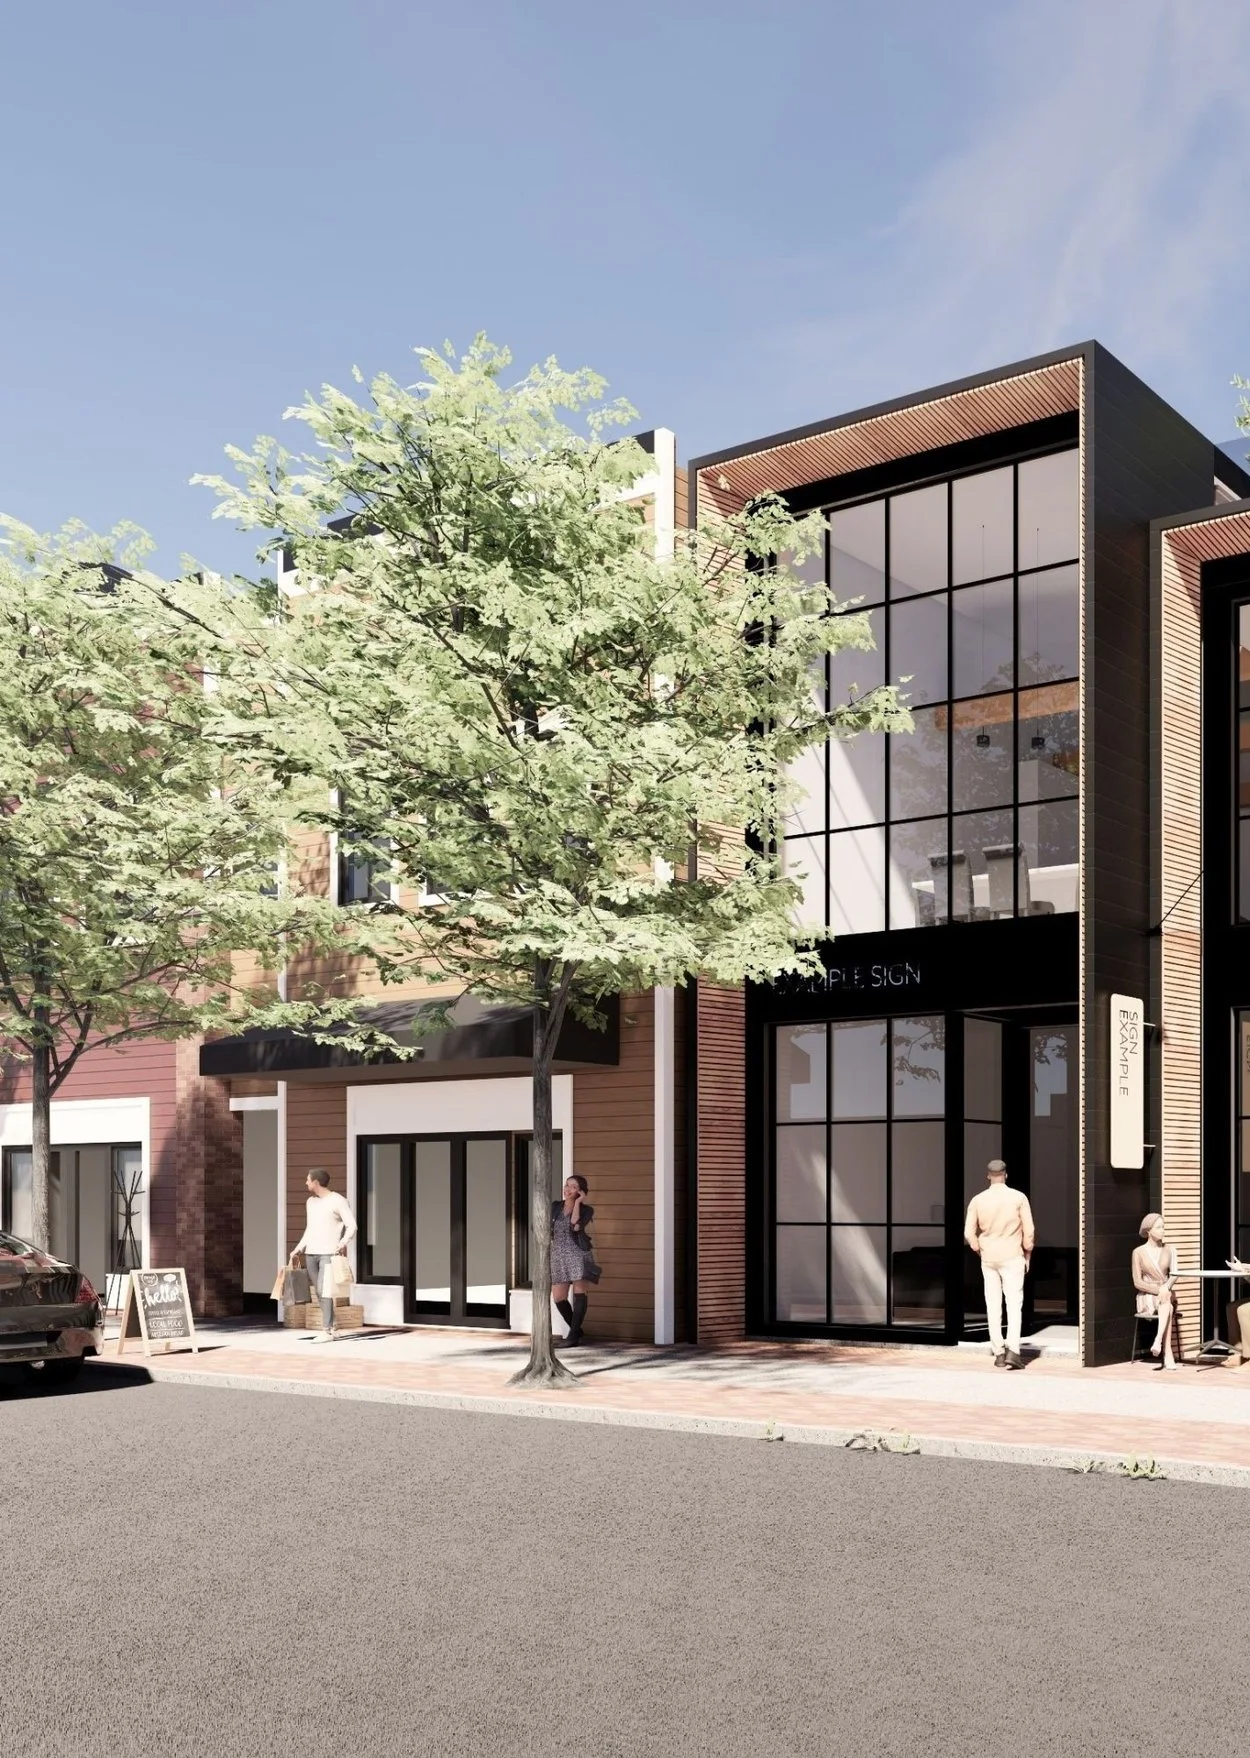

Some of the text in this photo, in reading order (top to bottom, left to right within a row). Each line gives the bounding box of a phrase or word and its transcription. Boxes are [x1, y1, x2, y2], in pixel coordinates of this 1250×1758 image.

[871, 962, 921, 987] SIGN
[1119, 1009, 1128, 1096] EXAMPLE
[1129, 1012, 1138, 1054] SIGN
